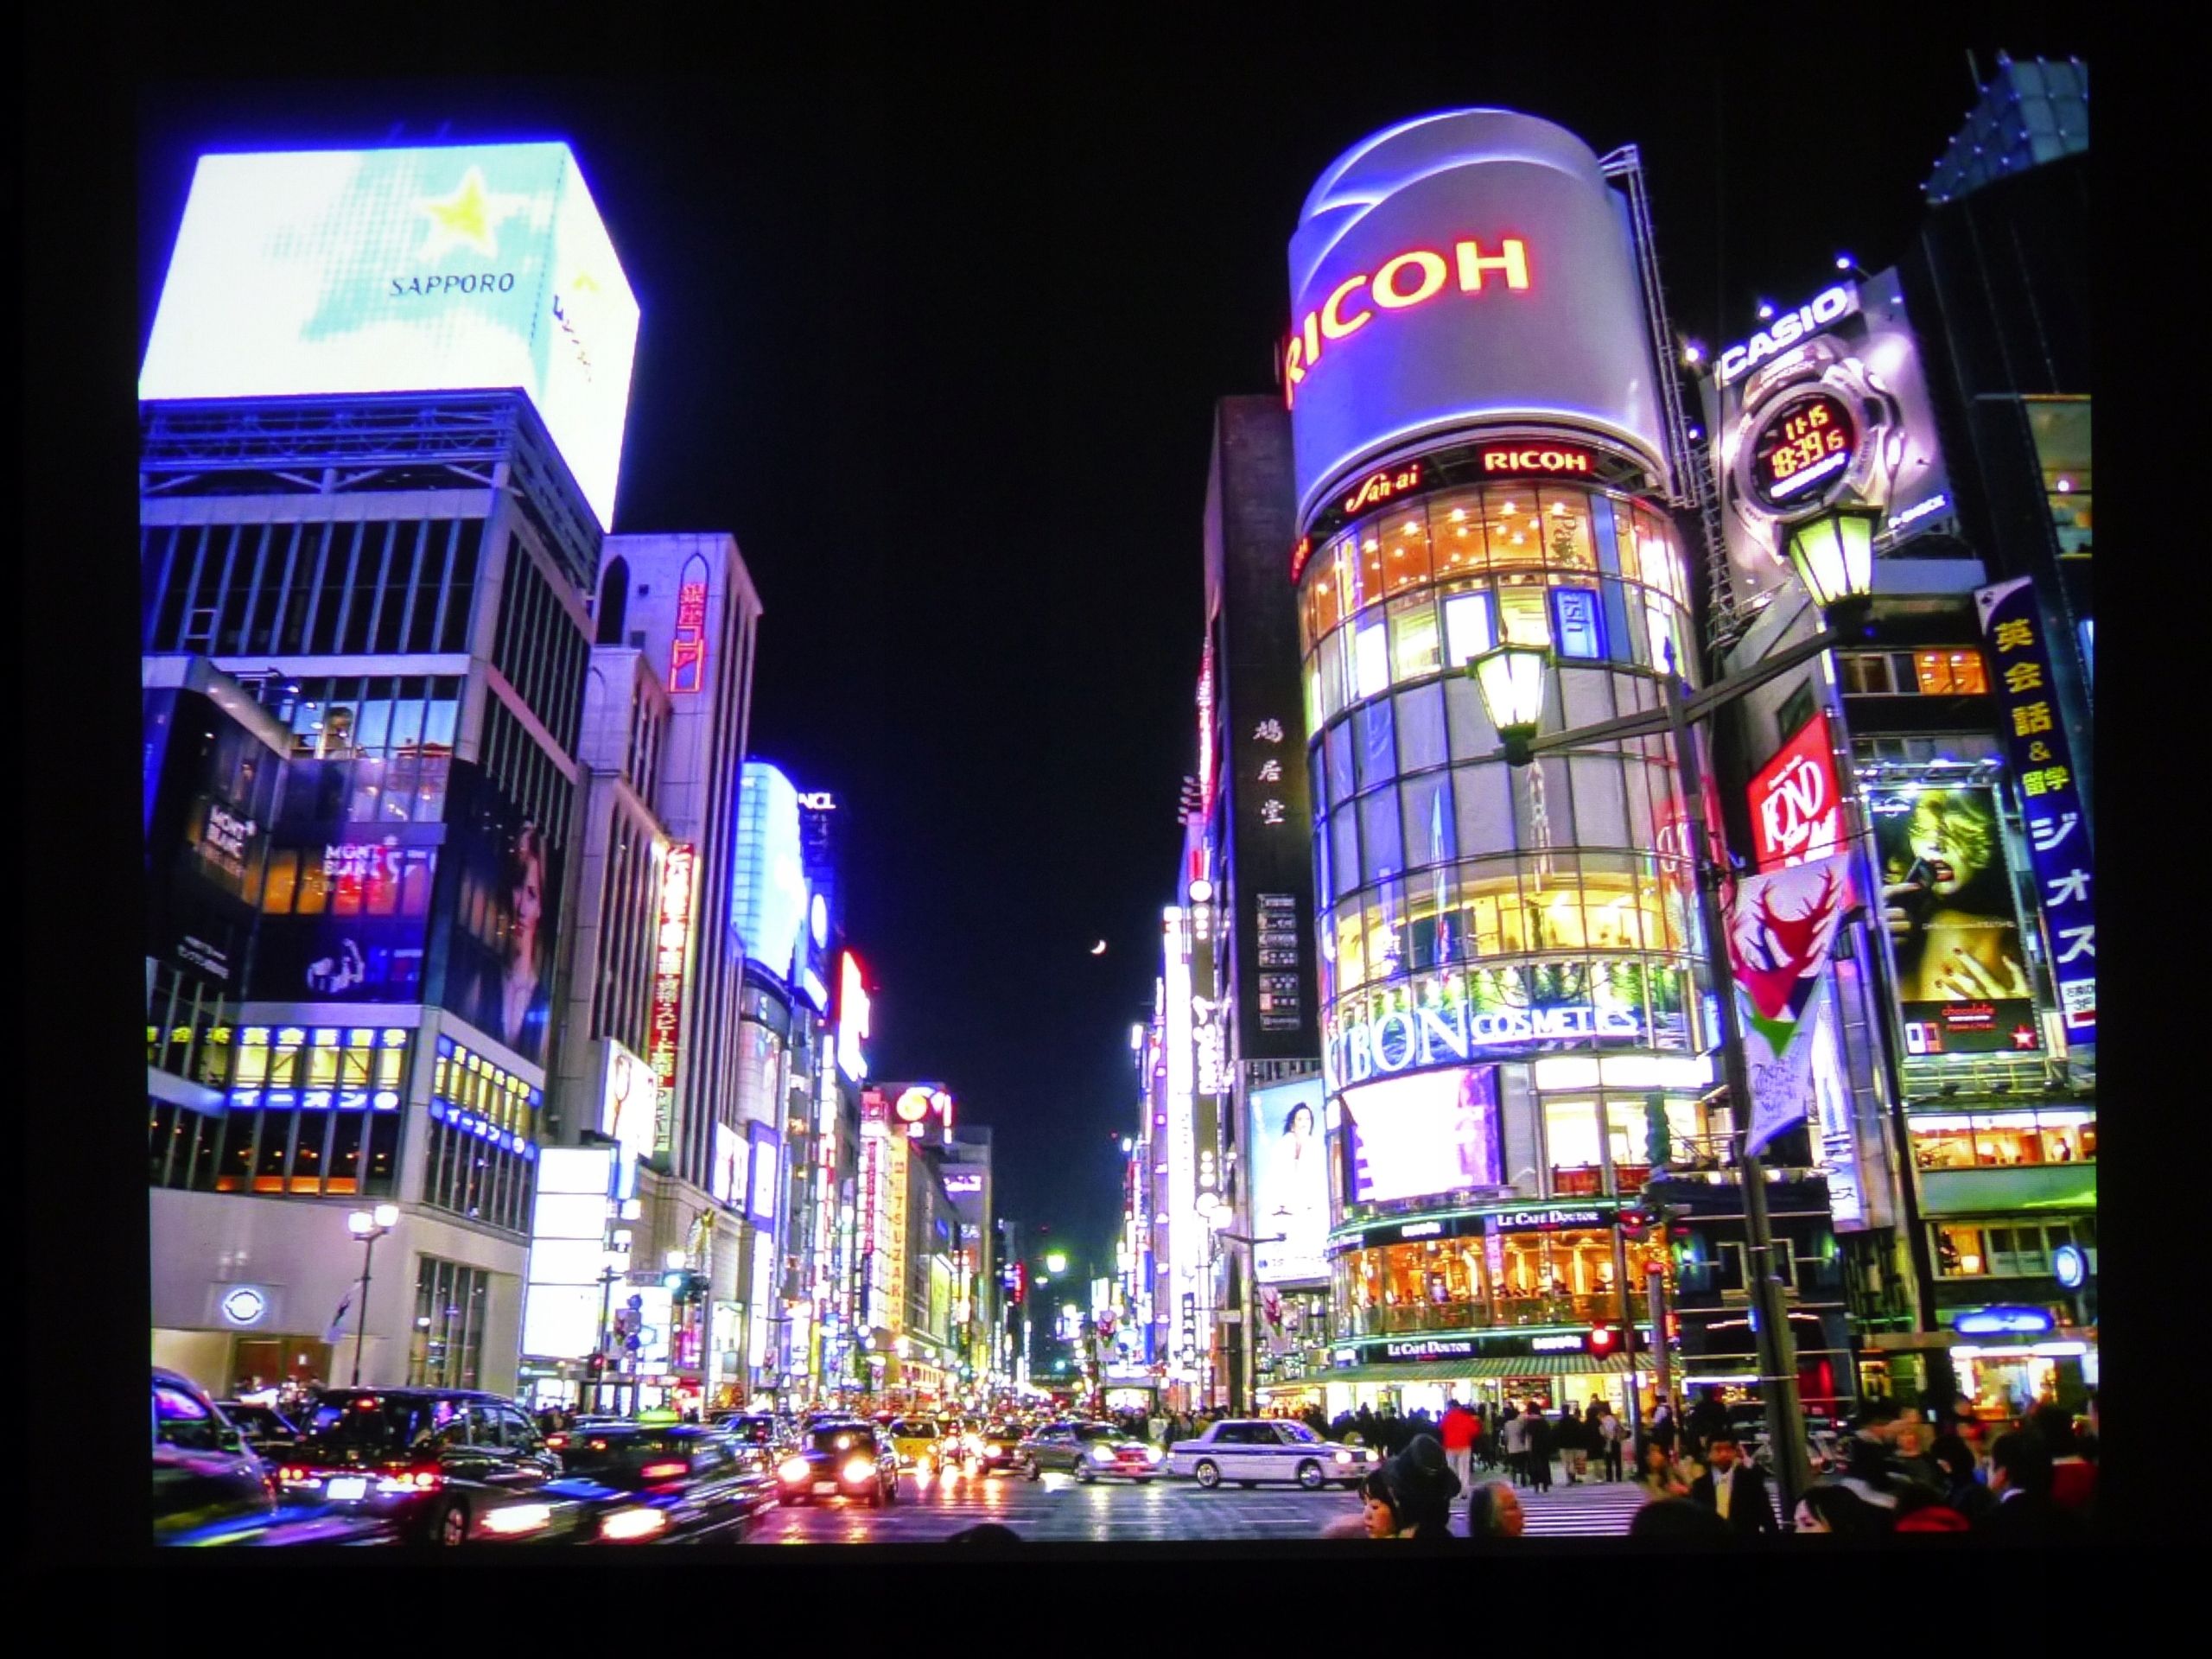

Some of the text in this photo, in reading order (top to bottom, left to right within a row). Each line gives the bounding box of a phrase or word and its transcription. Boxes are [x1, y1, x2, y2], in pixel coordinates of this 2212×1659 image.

[390, 272, 515, 296] SAPPORO
[1286, 238, 1529, 410] RICOH
[1720, 286, 1848, 381] CASIO
[1484, 450, 1588, 472] RICOH
[2031, 811, 2095, 964] ジオス
[1471, 1006, 1641, 1039] COSMETICS
